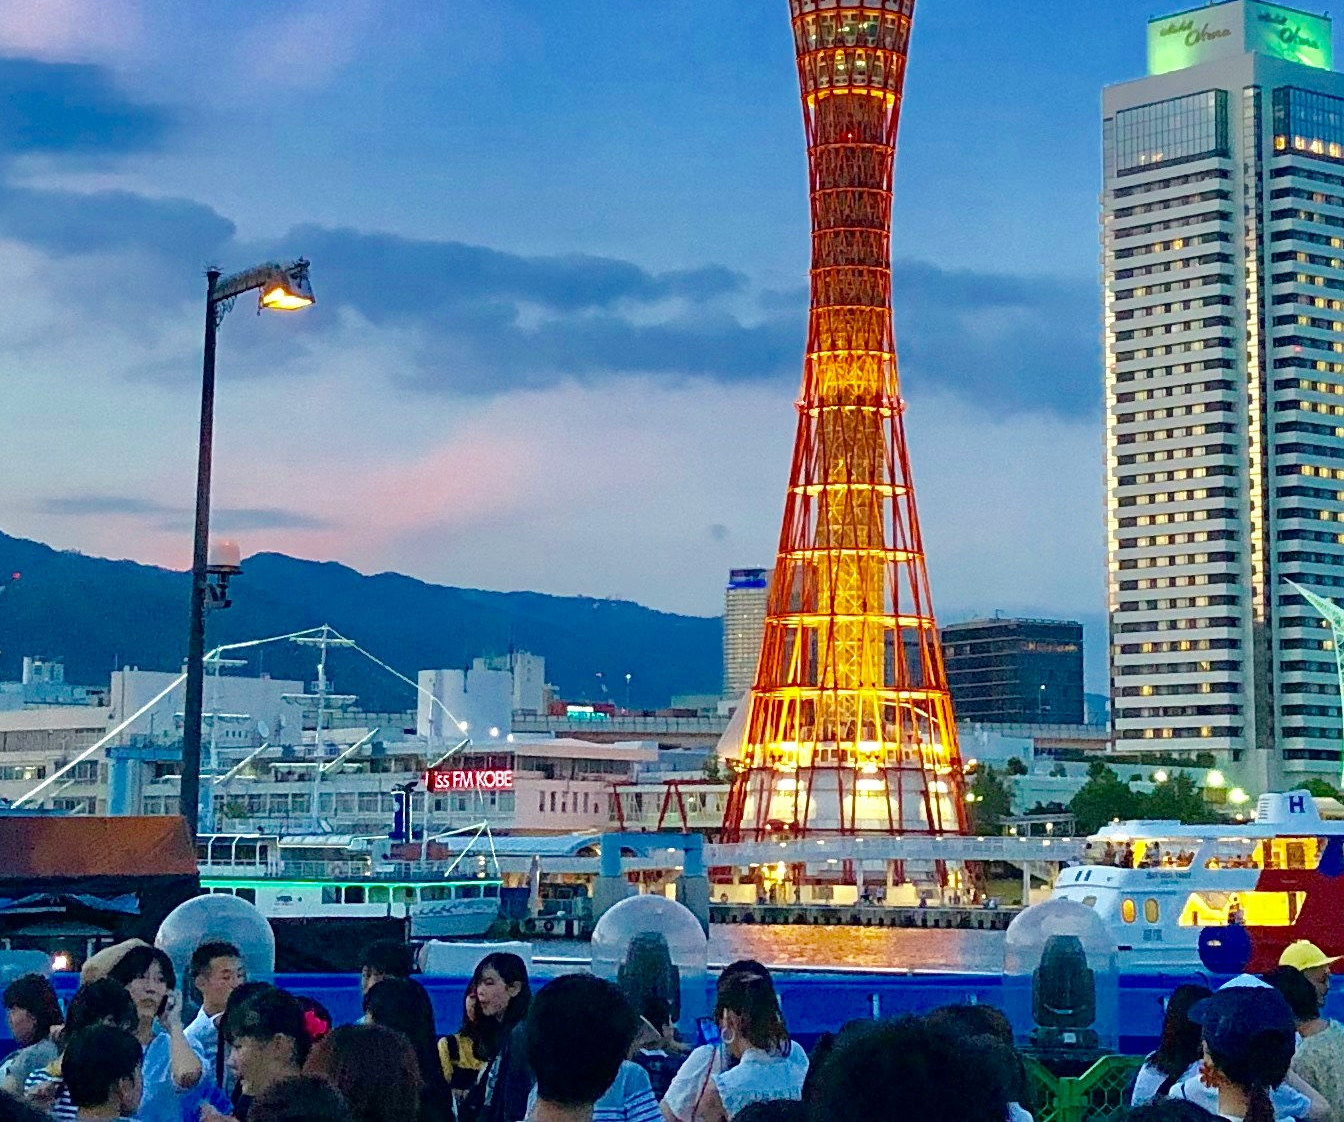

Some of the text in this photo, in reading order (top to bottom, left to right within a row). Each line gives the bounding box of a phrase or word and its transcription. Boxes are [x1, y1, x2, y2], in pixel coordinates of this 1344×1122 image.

[452, 771, 474, 788] FM
[476, 770, 513, 788] KOBE
[1288, 795, 1306, 814] H
